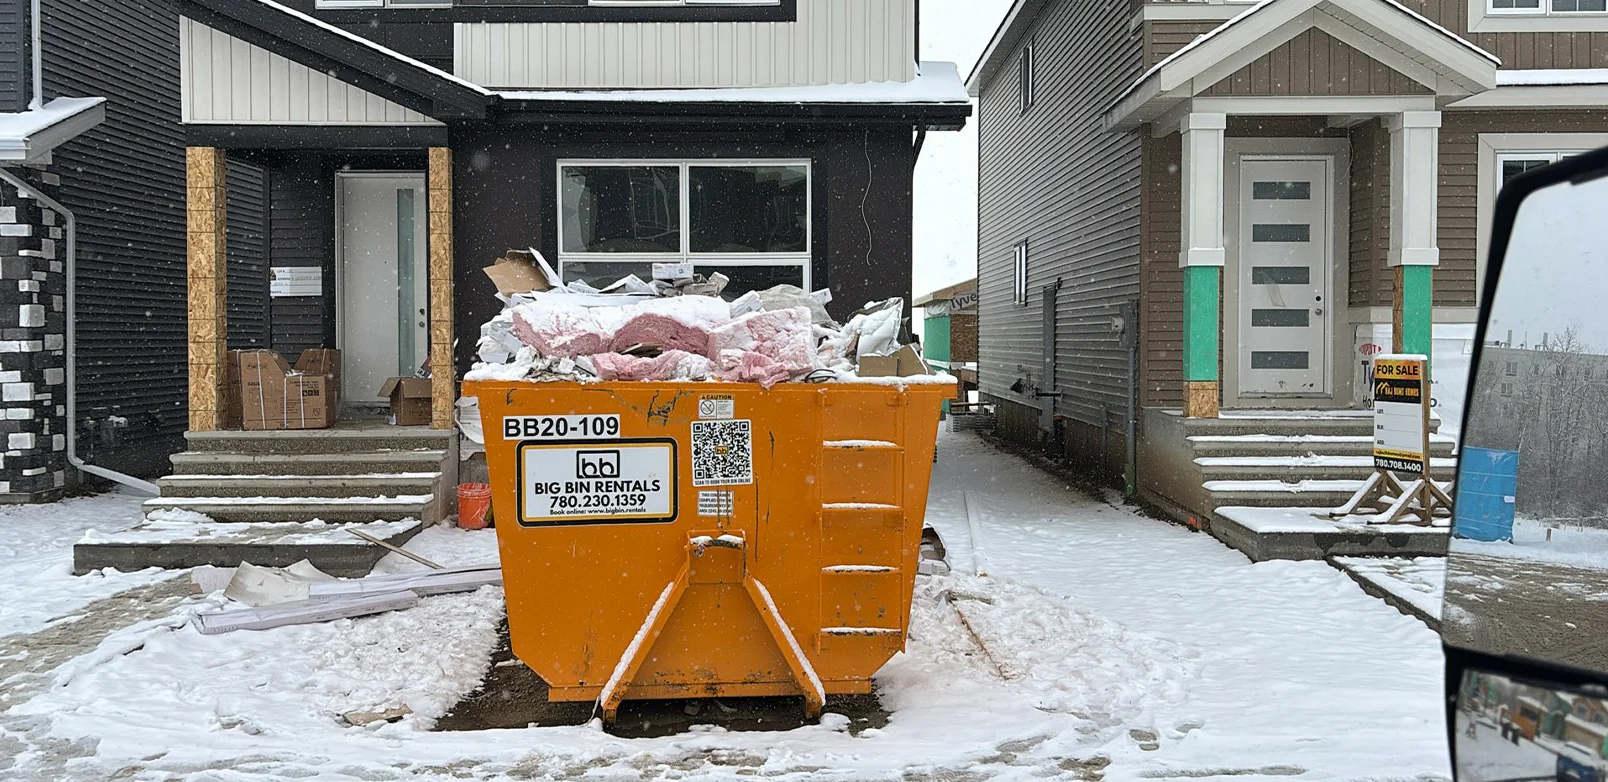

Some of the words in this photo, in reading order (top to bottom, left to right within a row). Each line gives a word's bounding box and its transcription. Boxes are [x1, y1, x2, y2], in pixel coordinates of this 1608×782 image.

[1376, 365, 1394, 375] FOR
[1395, 365, 1419, 376] SALE
[504, 416, 619, 438] BB20-109
[1375, 459, 1421, 472] 780.708.1400
[534, 482, 561, 495] BIG
[564, 481, 592, 494] BIN
[595, 479, 661, 493] RENTALS
[550, 494, 646, 509] 780.230.1359
[588, 506, 647, 514] www.bigbin.rentals
